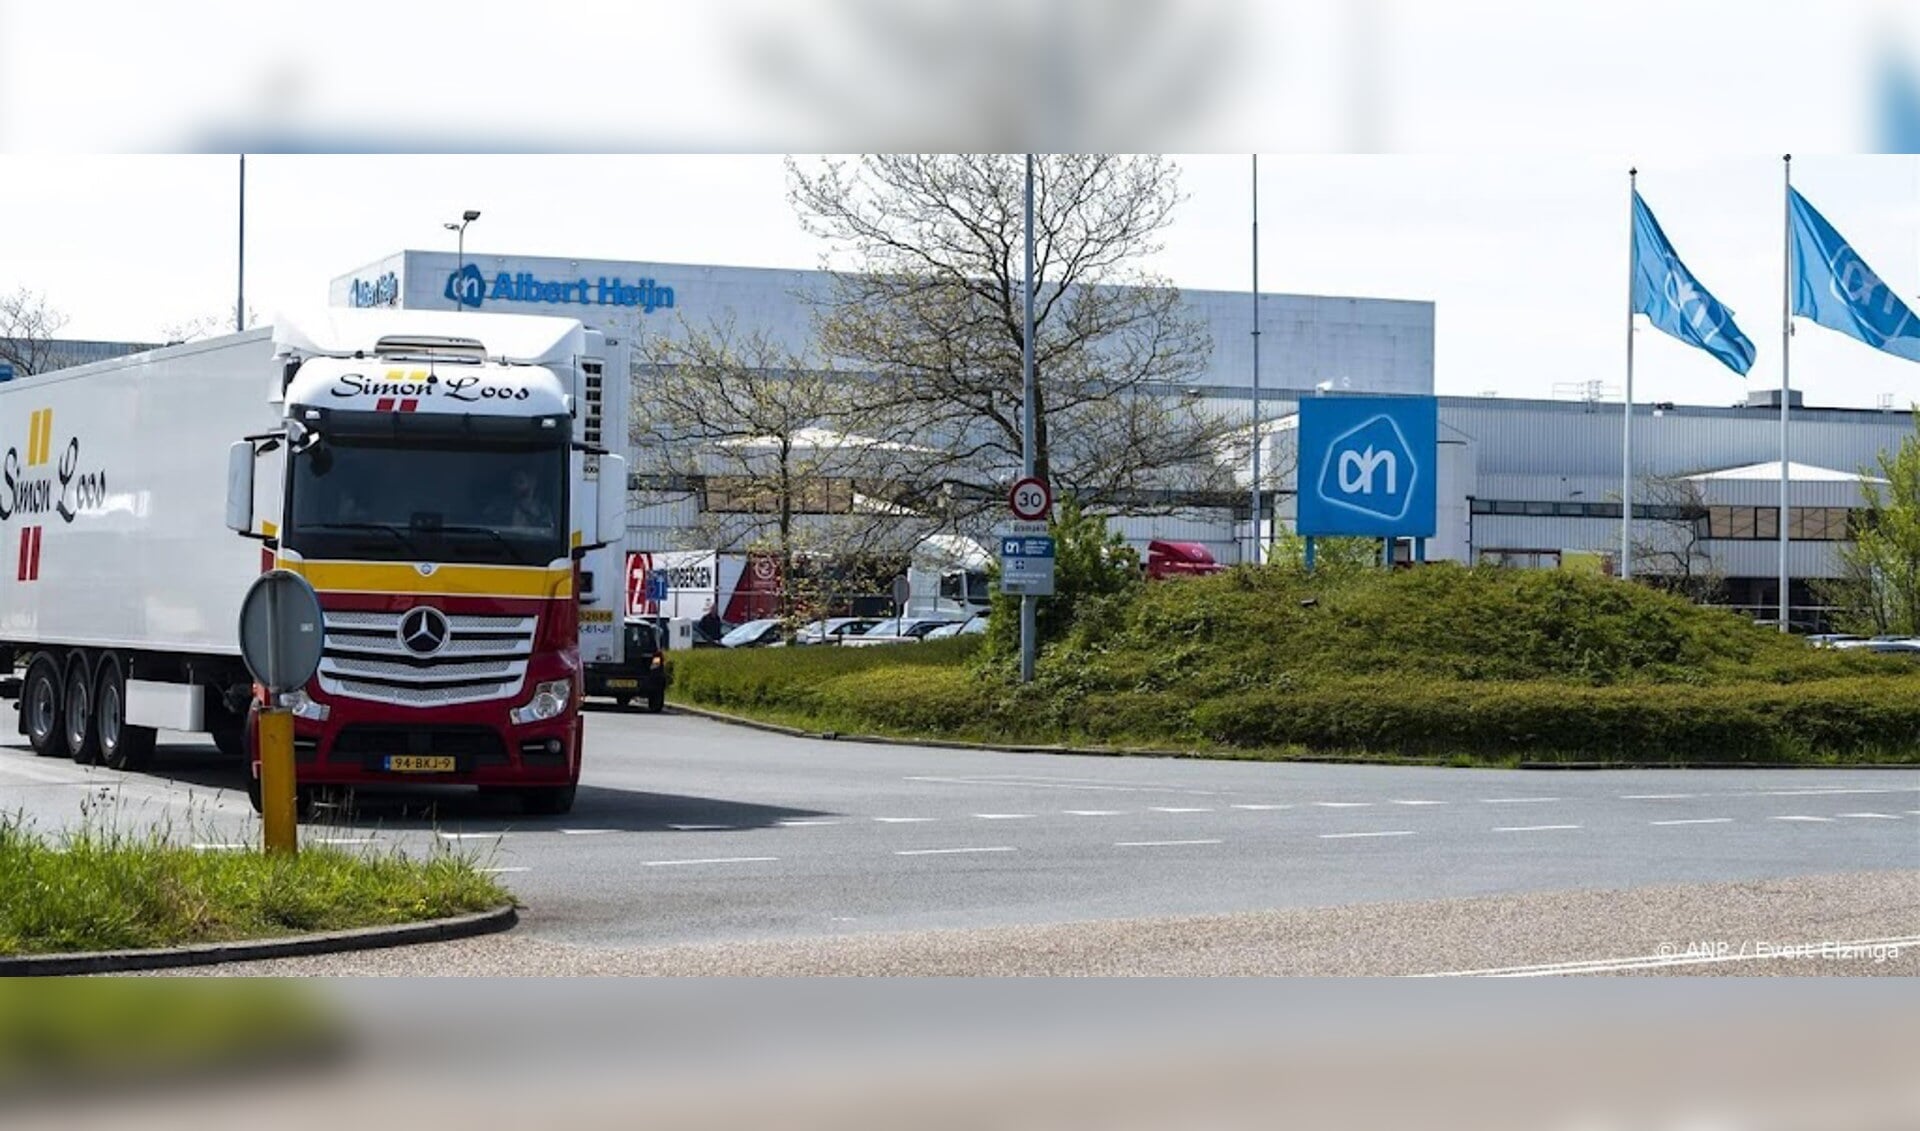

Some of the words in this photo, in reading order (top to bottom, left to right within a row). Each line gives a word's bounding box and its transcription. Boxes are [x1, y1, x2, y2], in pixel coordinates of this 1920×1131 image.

[491, 273, 590, 305] Albert
[599, 276, 675, 313] Heijn
[331, 373, 433, 398] Simon
[443, 377, 530, 402] Loos
[0, 447, 51, 521] Simon
[56, 437, 106, 523] Loos
[1018, 491, 1041, 508] 30
[394, 758, 451, 769] 94-BKJ-9
